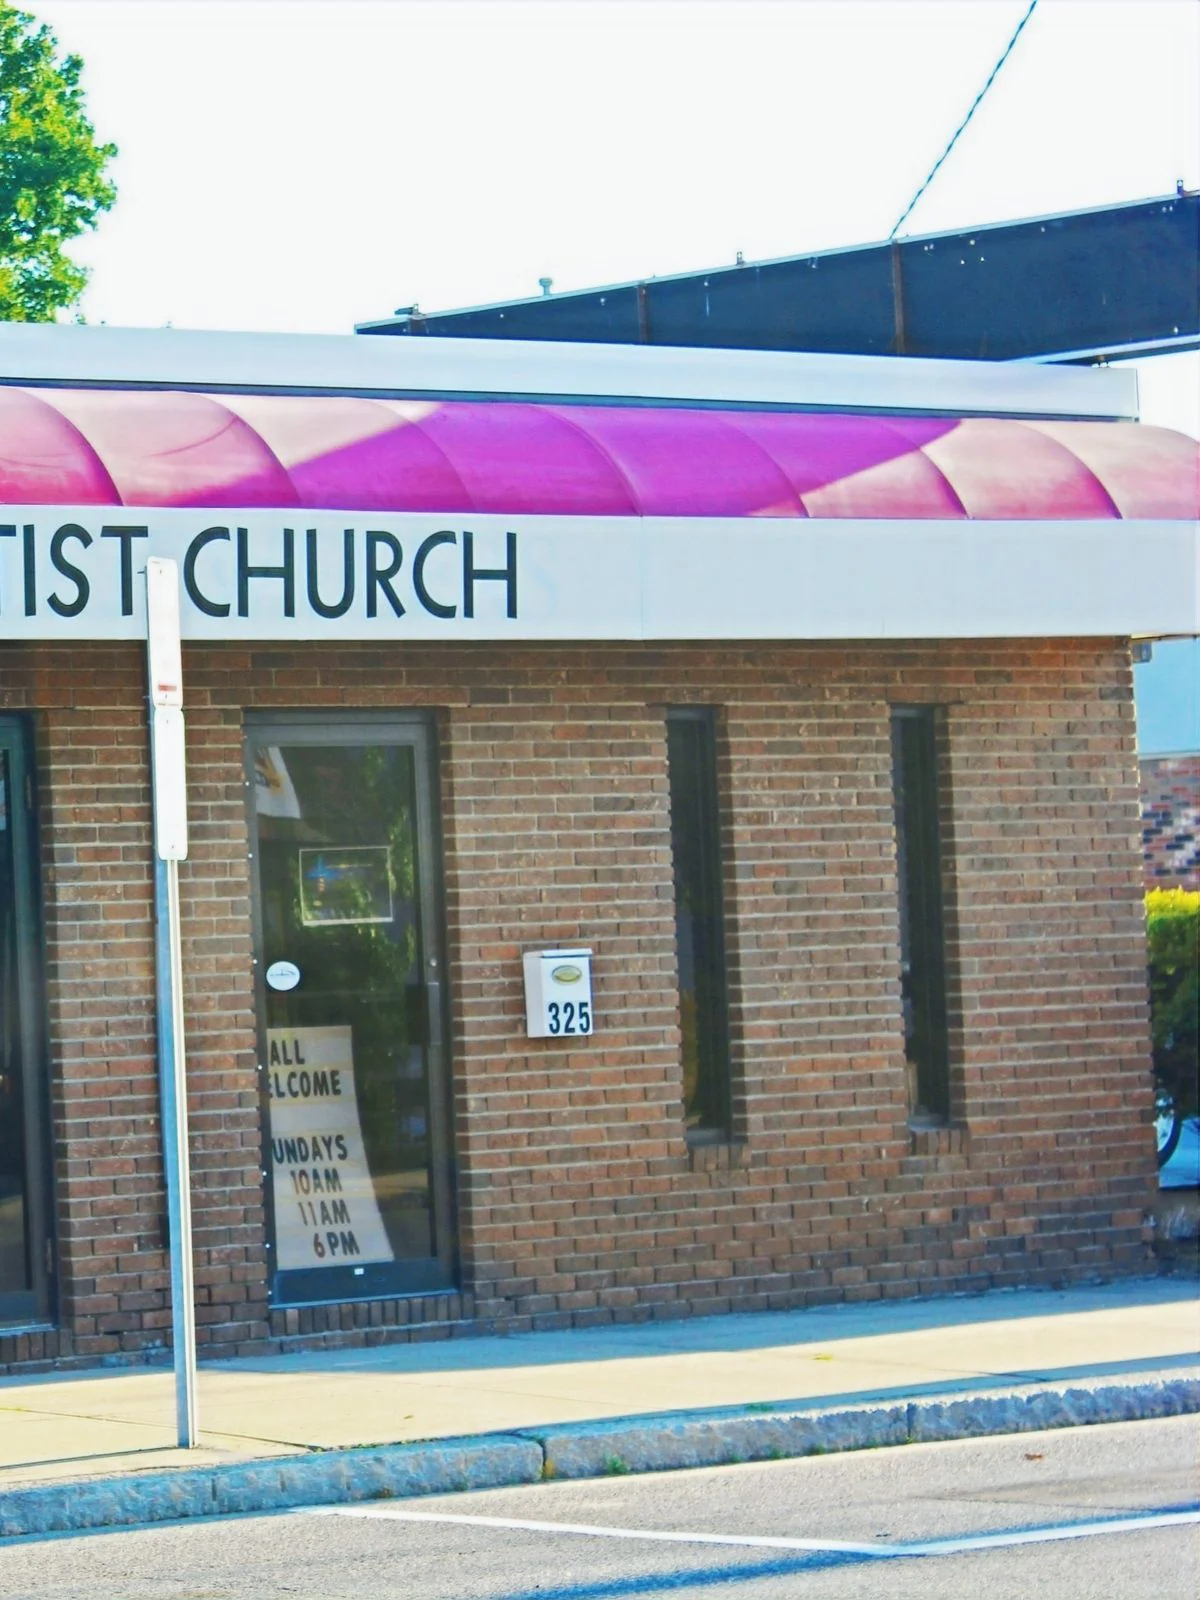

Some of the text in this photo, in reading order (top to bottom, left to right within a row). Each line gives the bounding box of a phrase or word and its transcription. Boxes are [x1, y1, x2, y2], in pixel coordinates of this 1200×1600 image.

[183, 525, 518, 619] CHURCH
[548, 1002, 590, 1034] 325
[270, 1040, 305, 1065] ALL
[268, 1070, 341, 1098] ELCOME
[273, 1135, 347, 1163] UNDAYS
